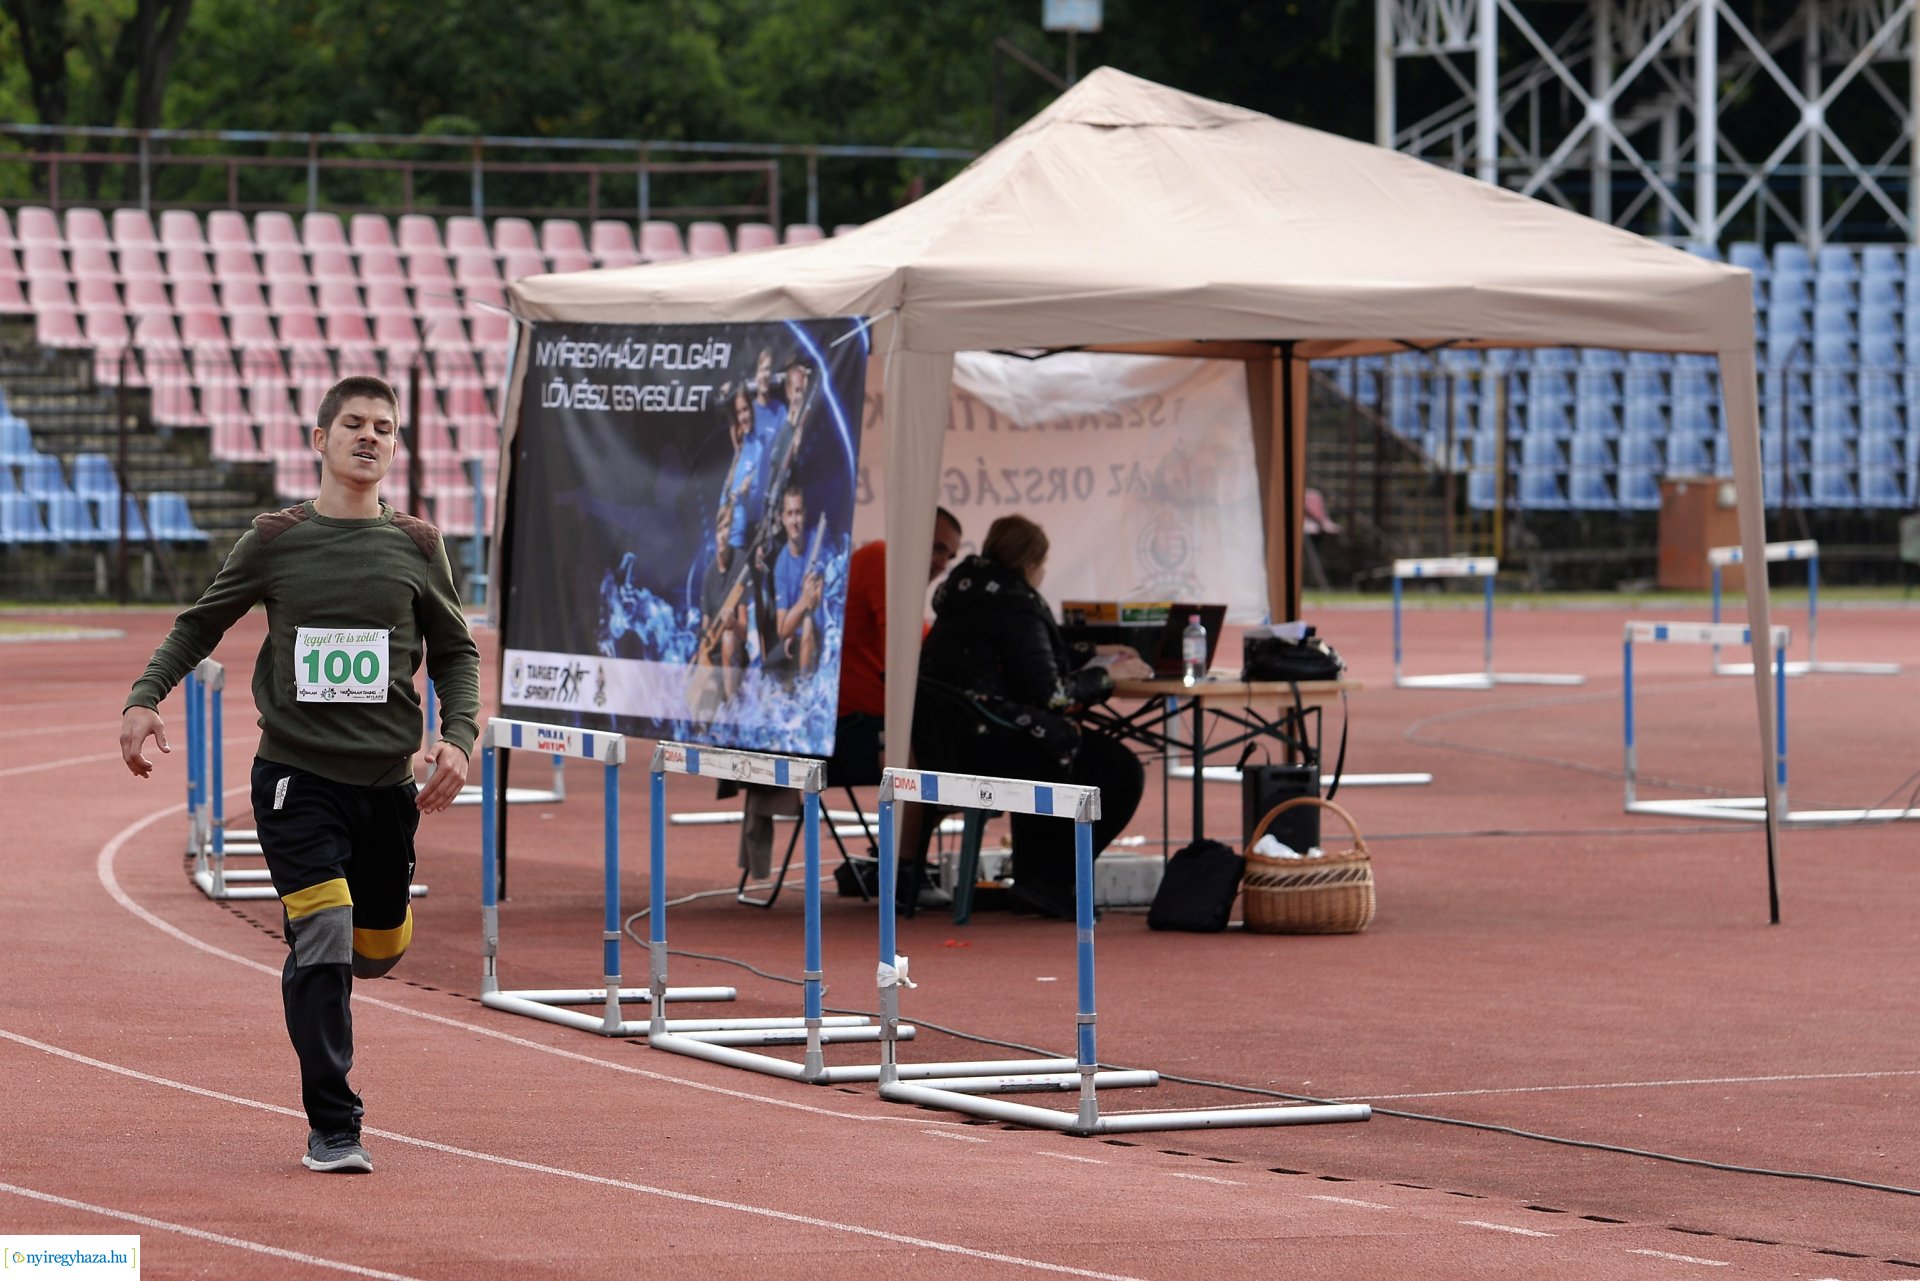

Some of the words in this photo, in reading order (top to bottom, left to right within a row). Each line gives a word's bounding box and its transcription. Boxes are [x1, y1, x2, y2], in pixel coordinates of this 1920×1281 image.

[536, 335, 647, 369] NYÍREGYHÁZI
[649, 337, 731, 370] POLGÁRI
[612, 380, 713, 412] EGYESÜLET
[303, 649, 380, 684] 100
[527, 665, 559, 680] TARGET
[525, 685, 557, 700] SPRINT
[894, 776, 917, 791] DIMA
